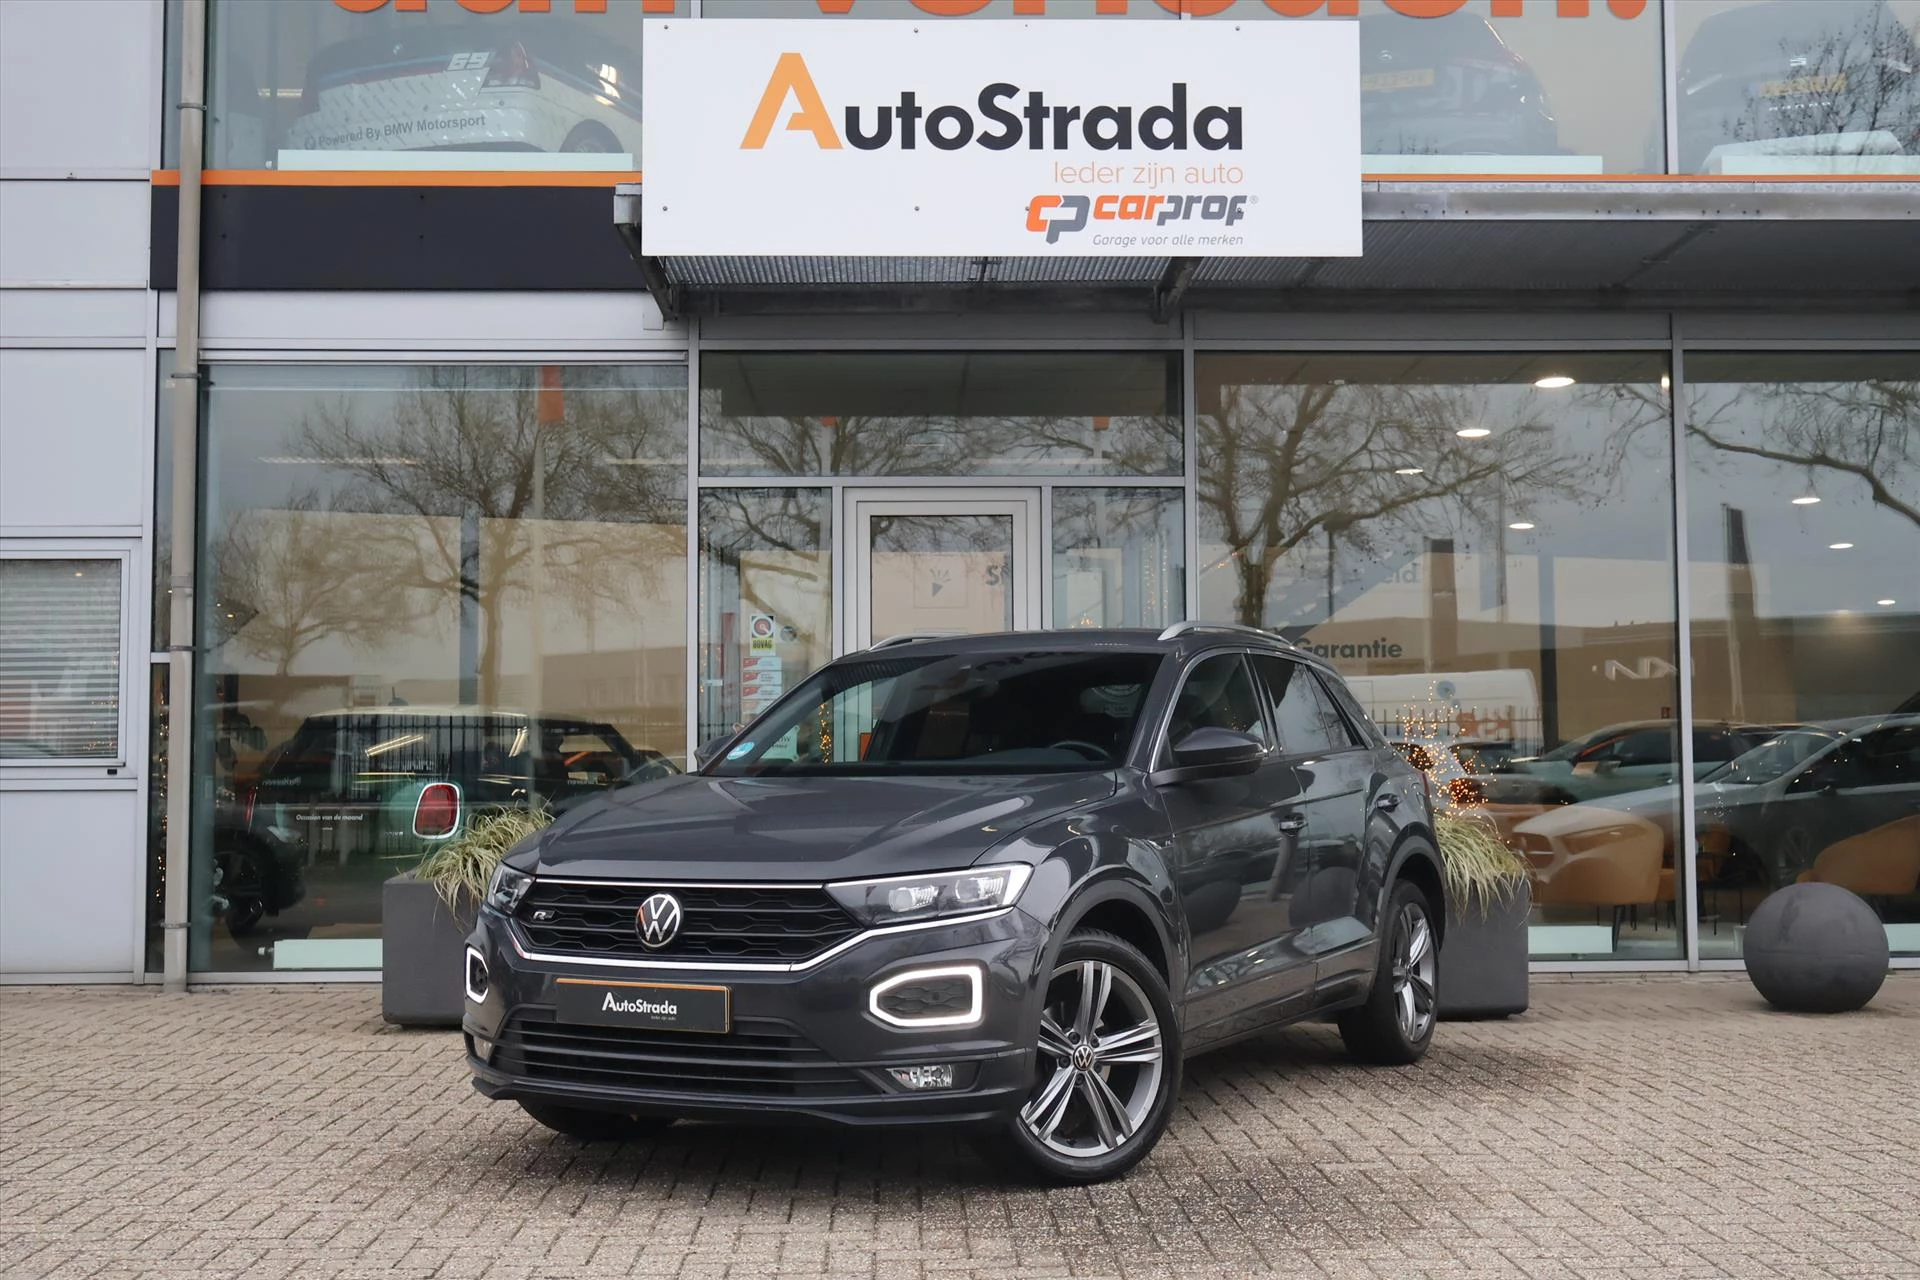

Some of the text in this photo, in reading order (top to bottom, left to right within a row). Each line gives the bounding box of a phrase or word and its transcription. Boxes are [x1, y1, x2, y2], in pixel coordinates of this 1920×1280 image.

[449, 52, 487, 71] 69
[740, 52, 1243, 151] AutoStrada
[318, 115, 487, 146] Powered By BMW Motorsport
[1054, 161, 1244, 189] Ieder zijn auto
[1093, 234, 1244, 248] Garage voor alle merken
[602, 992, 677, 1015] AutoStrada
